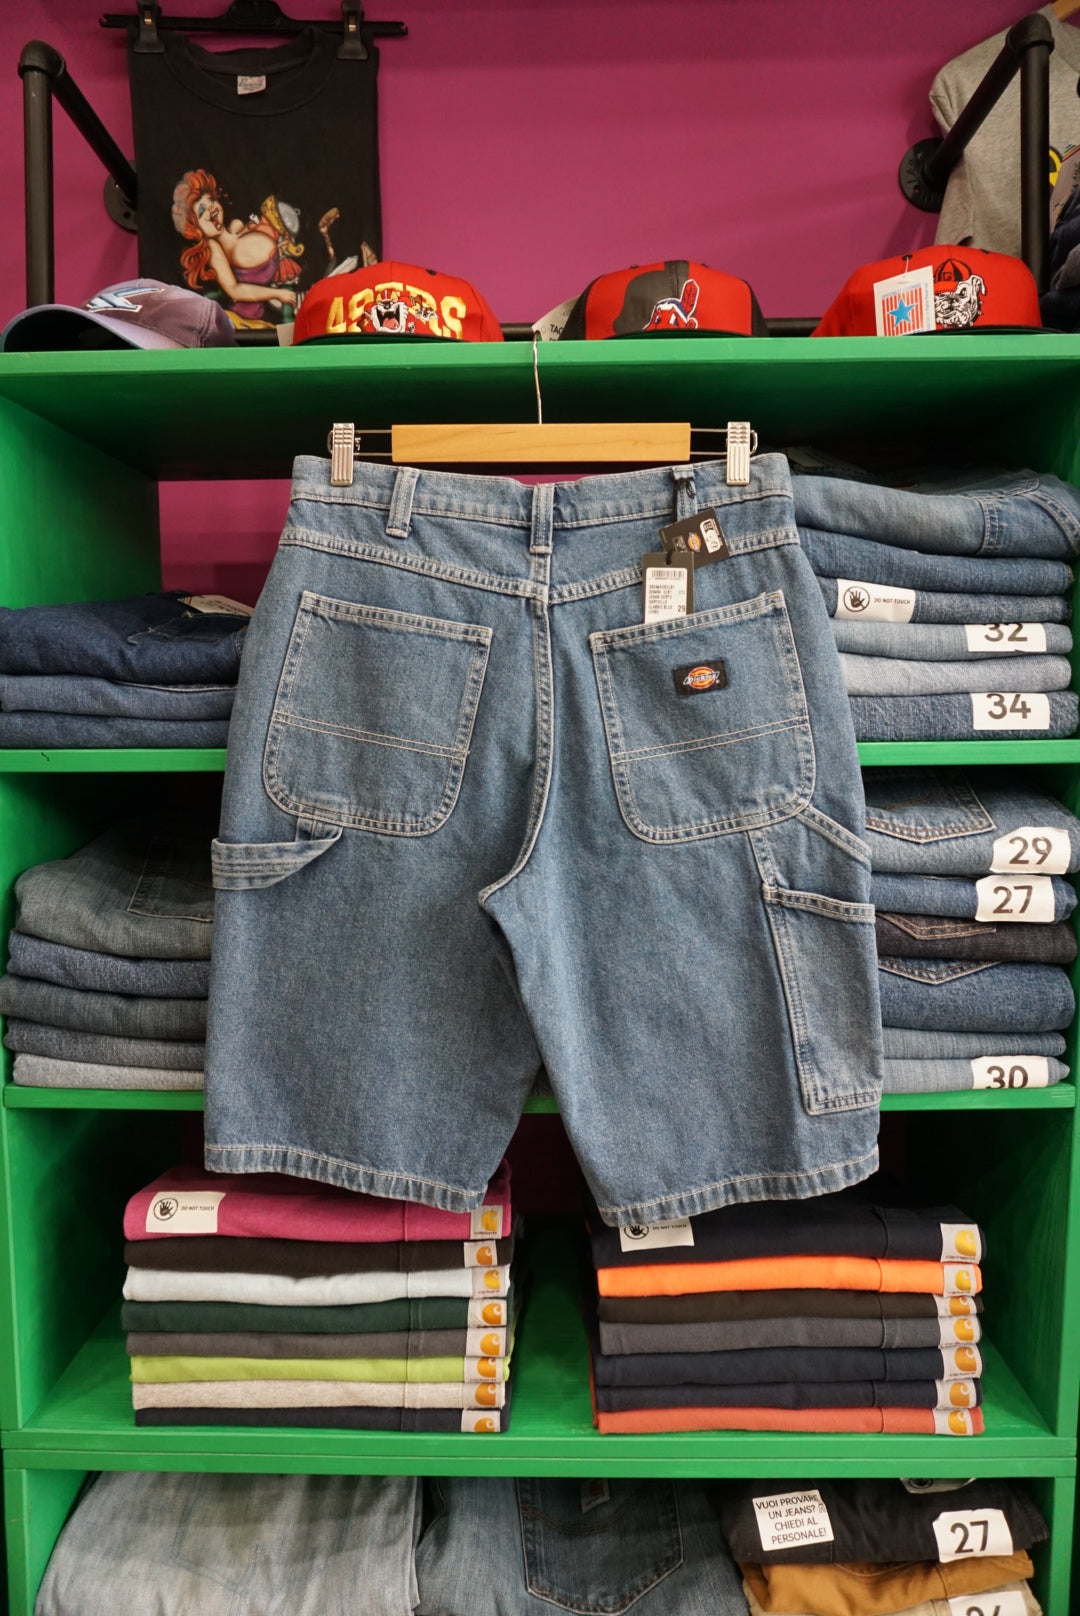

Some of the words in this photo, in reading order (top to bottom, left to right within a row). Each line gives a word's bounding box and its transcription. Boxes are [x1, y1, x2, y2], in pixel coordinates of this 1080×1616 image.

[326, 281, 467, 340] 49RS
[984, 623, 1028, 643] 32
[987, 693, 1032, 720] 34
[1009, 836, 1053, 865] 29
[992, 885, 1033, 914] 27
[985, 1065, 1029, 1089] 30
[755, 1500, 779, 1510] VUOI
[781, 1494, 818, 1506] PROVARE
[768, 1510, 782, 1520] UN
[784, 1504, 816, 1518] JEANS?
[771, 1527, 827, 1545] PERSONALE!
[774, 1519, 805, 1531] CHIEDI
[807, 1517, 819, 1526] AL
[950, 1520, 989, 1554] 27
